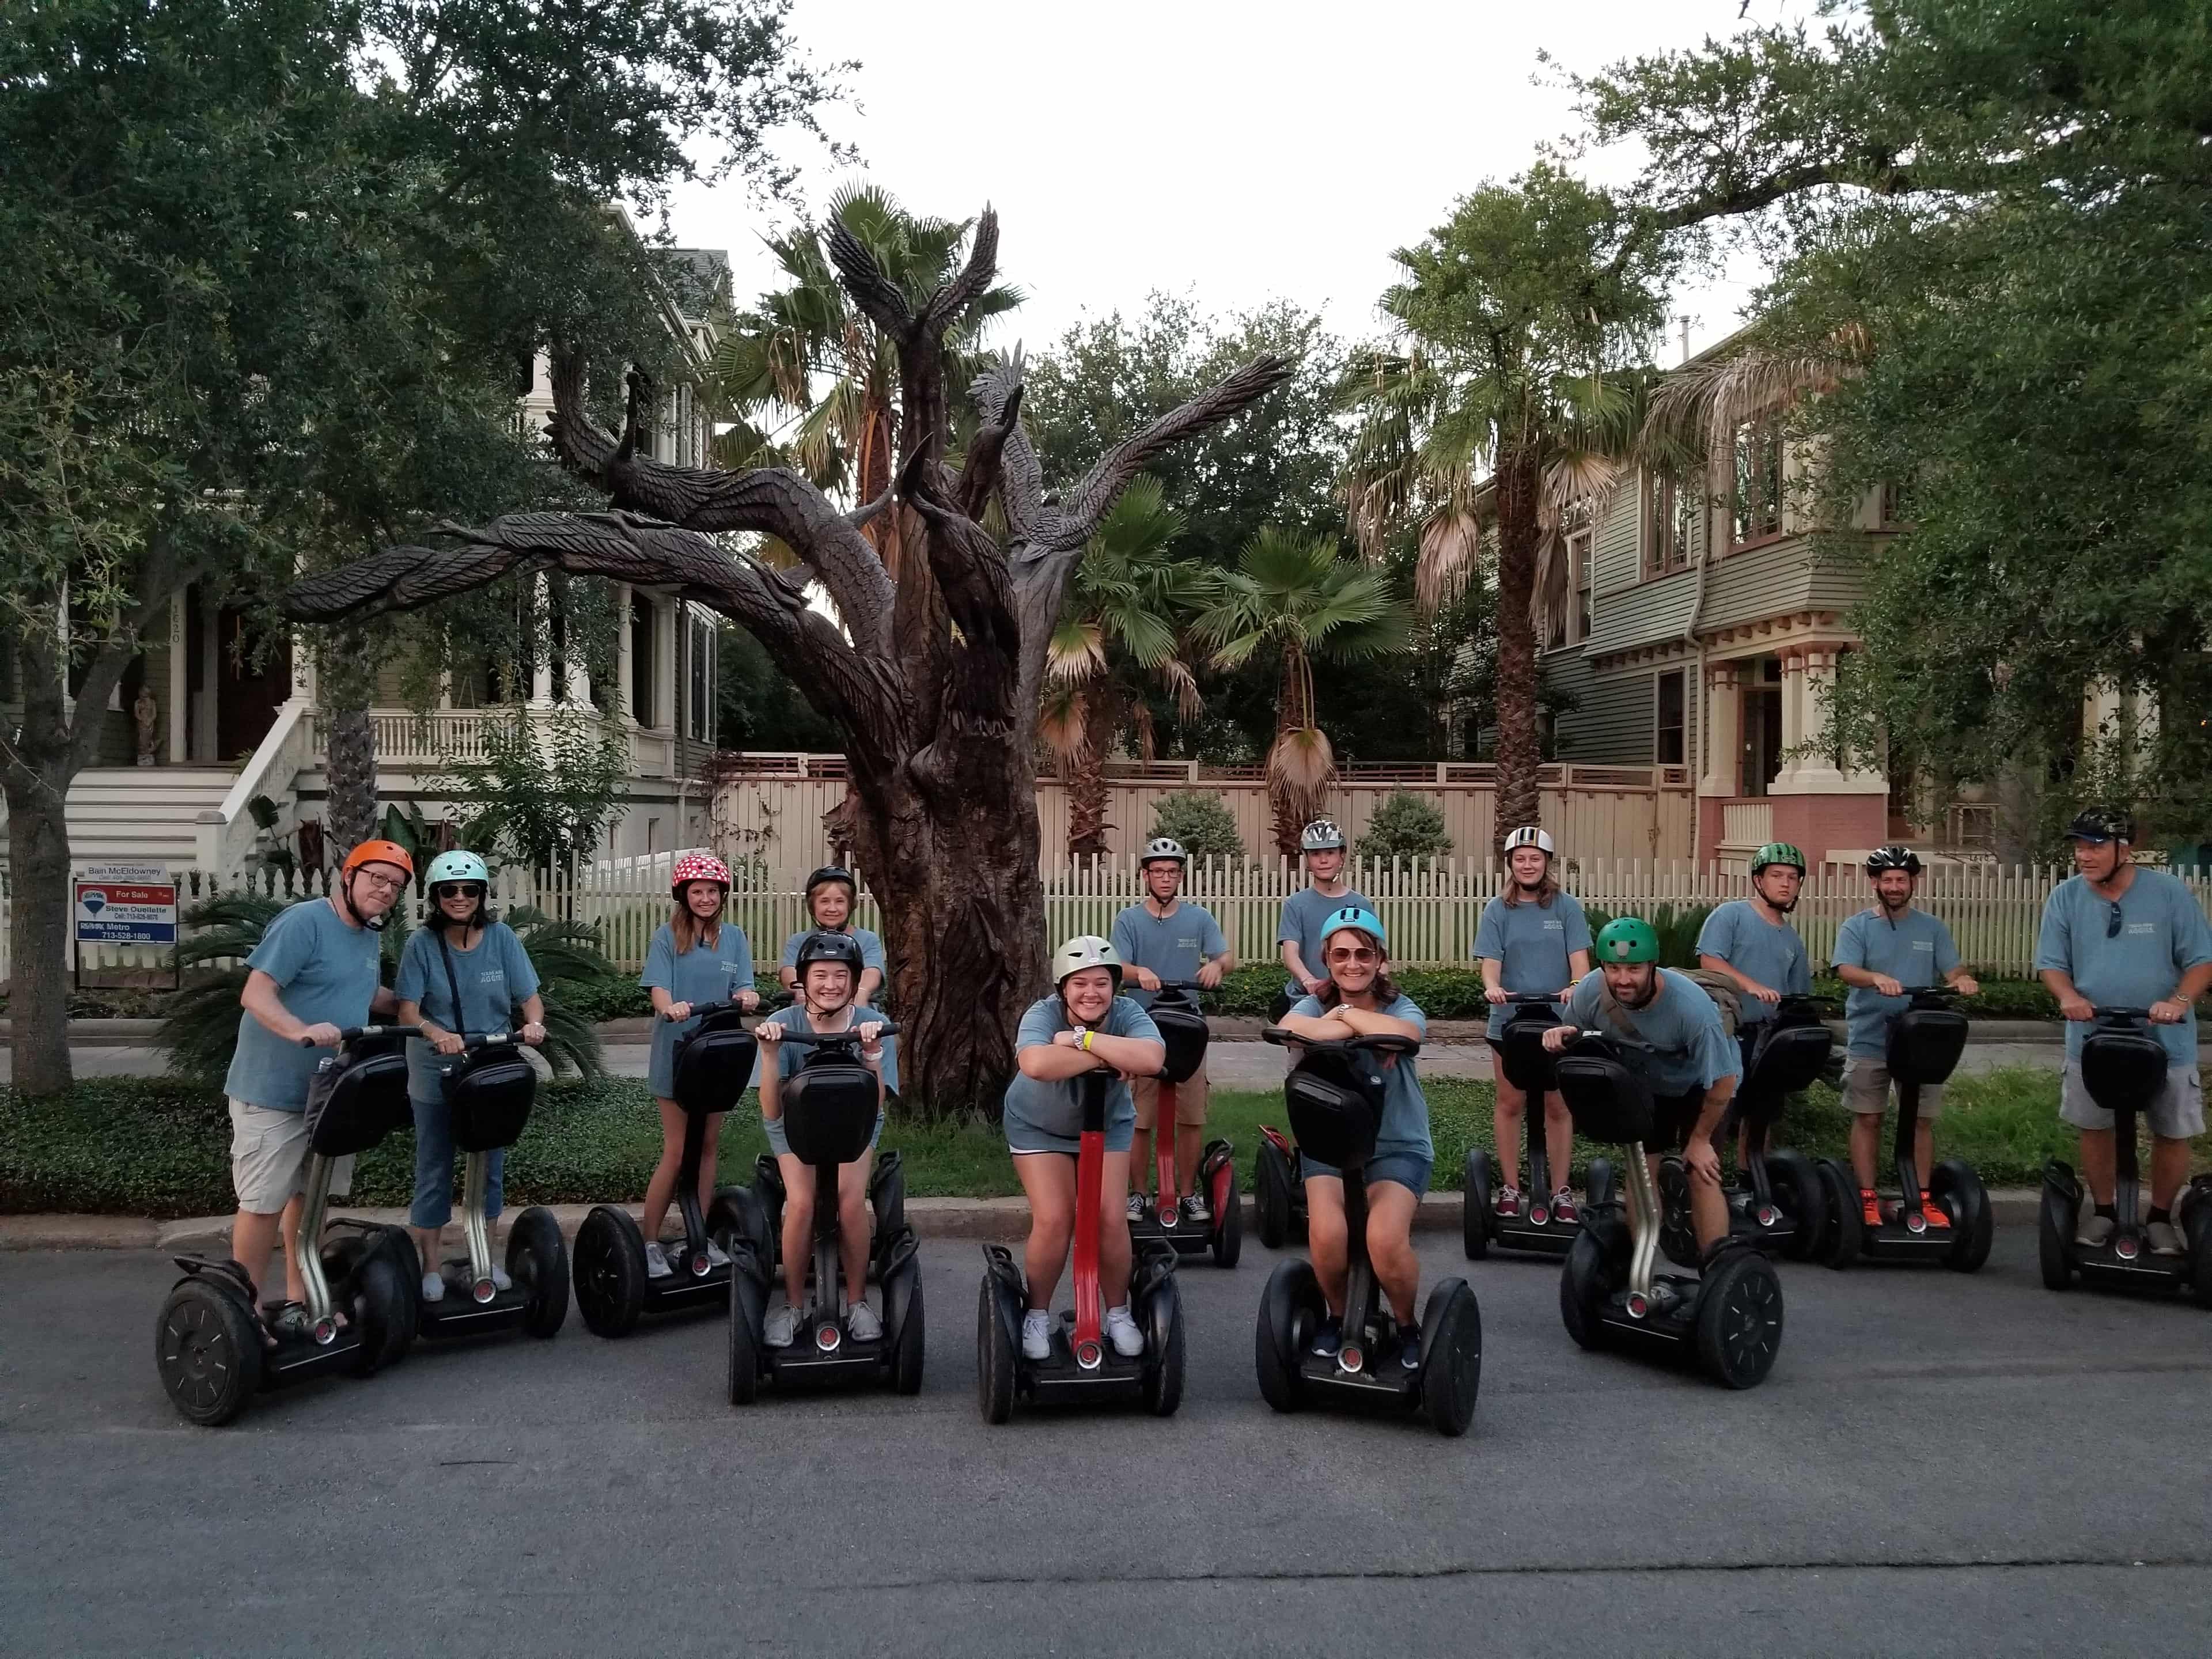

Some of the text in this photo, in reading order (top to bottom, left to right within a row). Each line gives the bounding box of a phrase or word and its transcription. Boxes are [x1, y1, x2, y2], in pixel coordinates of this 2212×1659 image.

[109, 867, 161, 876] McEldowney
[131, 891, 148, 899] Sale
[107, 923, 130, 931] Metro
